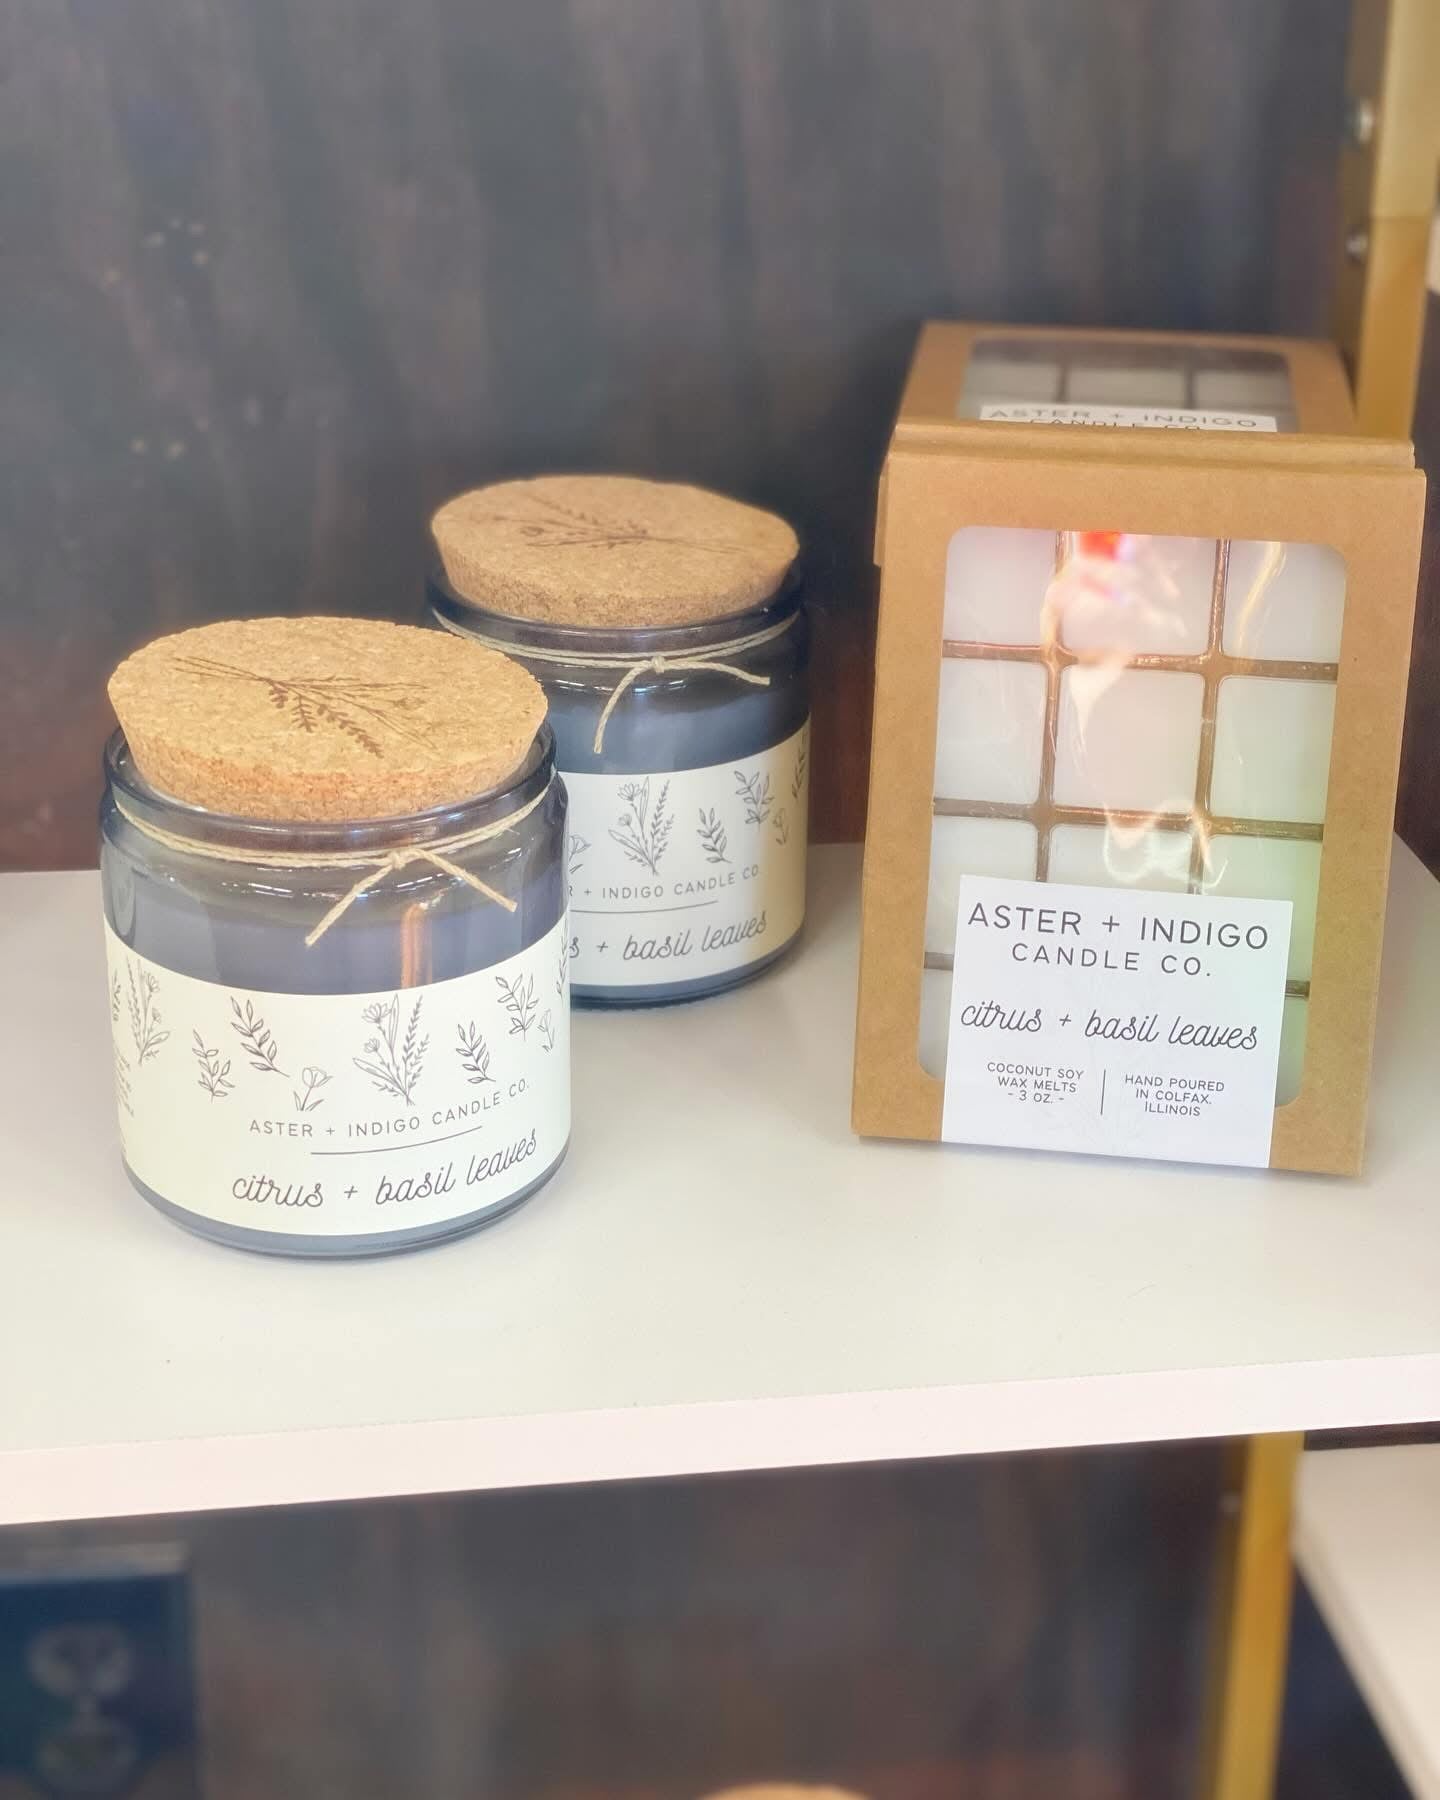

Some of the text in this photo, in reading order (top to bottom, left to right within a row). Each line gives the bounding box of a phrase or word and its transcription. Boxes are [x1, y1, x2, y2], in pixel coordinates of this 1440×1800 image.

[989, 409, 1091, 419] ASTER
[1143, 414, 1257, 427] INDIGO
[584, 888, 592, 896] +
[603, 885, 663, 899] INDIGO
[674, 875, 735, 895] CANDLE
[597, 941, 608, 952] +
[623, 929, 692, 960] basil
[701, 911, 766, 952] leaves
[968, 903, 1267, 949] ASTER + INDIGO
[1012, 943, 1210, 976] CANDLE CO.
[961, 1000, 1257, 1050] citrus + basil leaves
[986, 1062, 1084, 1080] COCONUT SOY
[998, 1076, 1076, 1094] WAX MELTS
[1125, 1074, 1225, 1092] HAND POURED
[1136, 1088, 1149, 1099] IN
[1019, 1090, 1027, 1101] 3
[250, 1120, 312, 1137] ASTER
[326, 1128, 335, 1136] +
[349, 1116, 420, 1137] INDIGO
[431, 1091, 501, 1125] CANDLE
[1144, 1101, 1201, 1117] ILLINOIS
[232, 1128, 537, 1207] citrus + basil leaves
